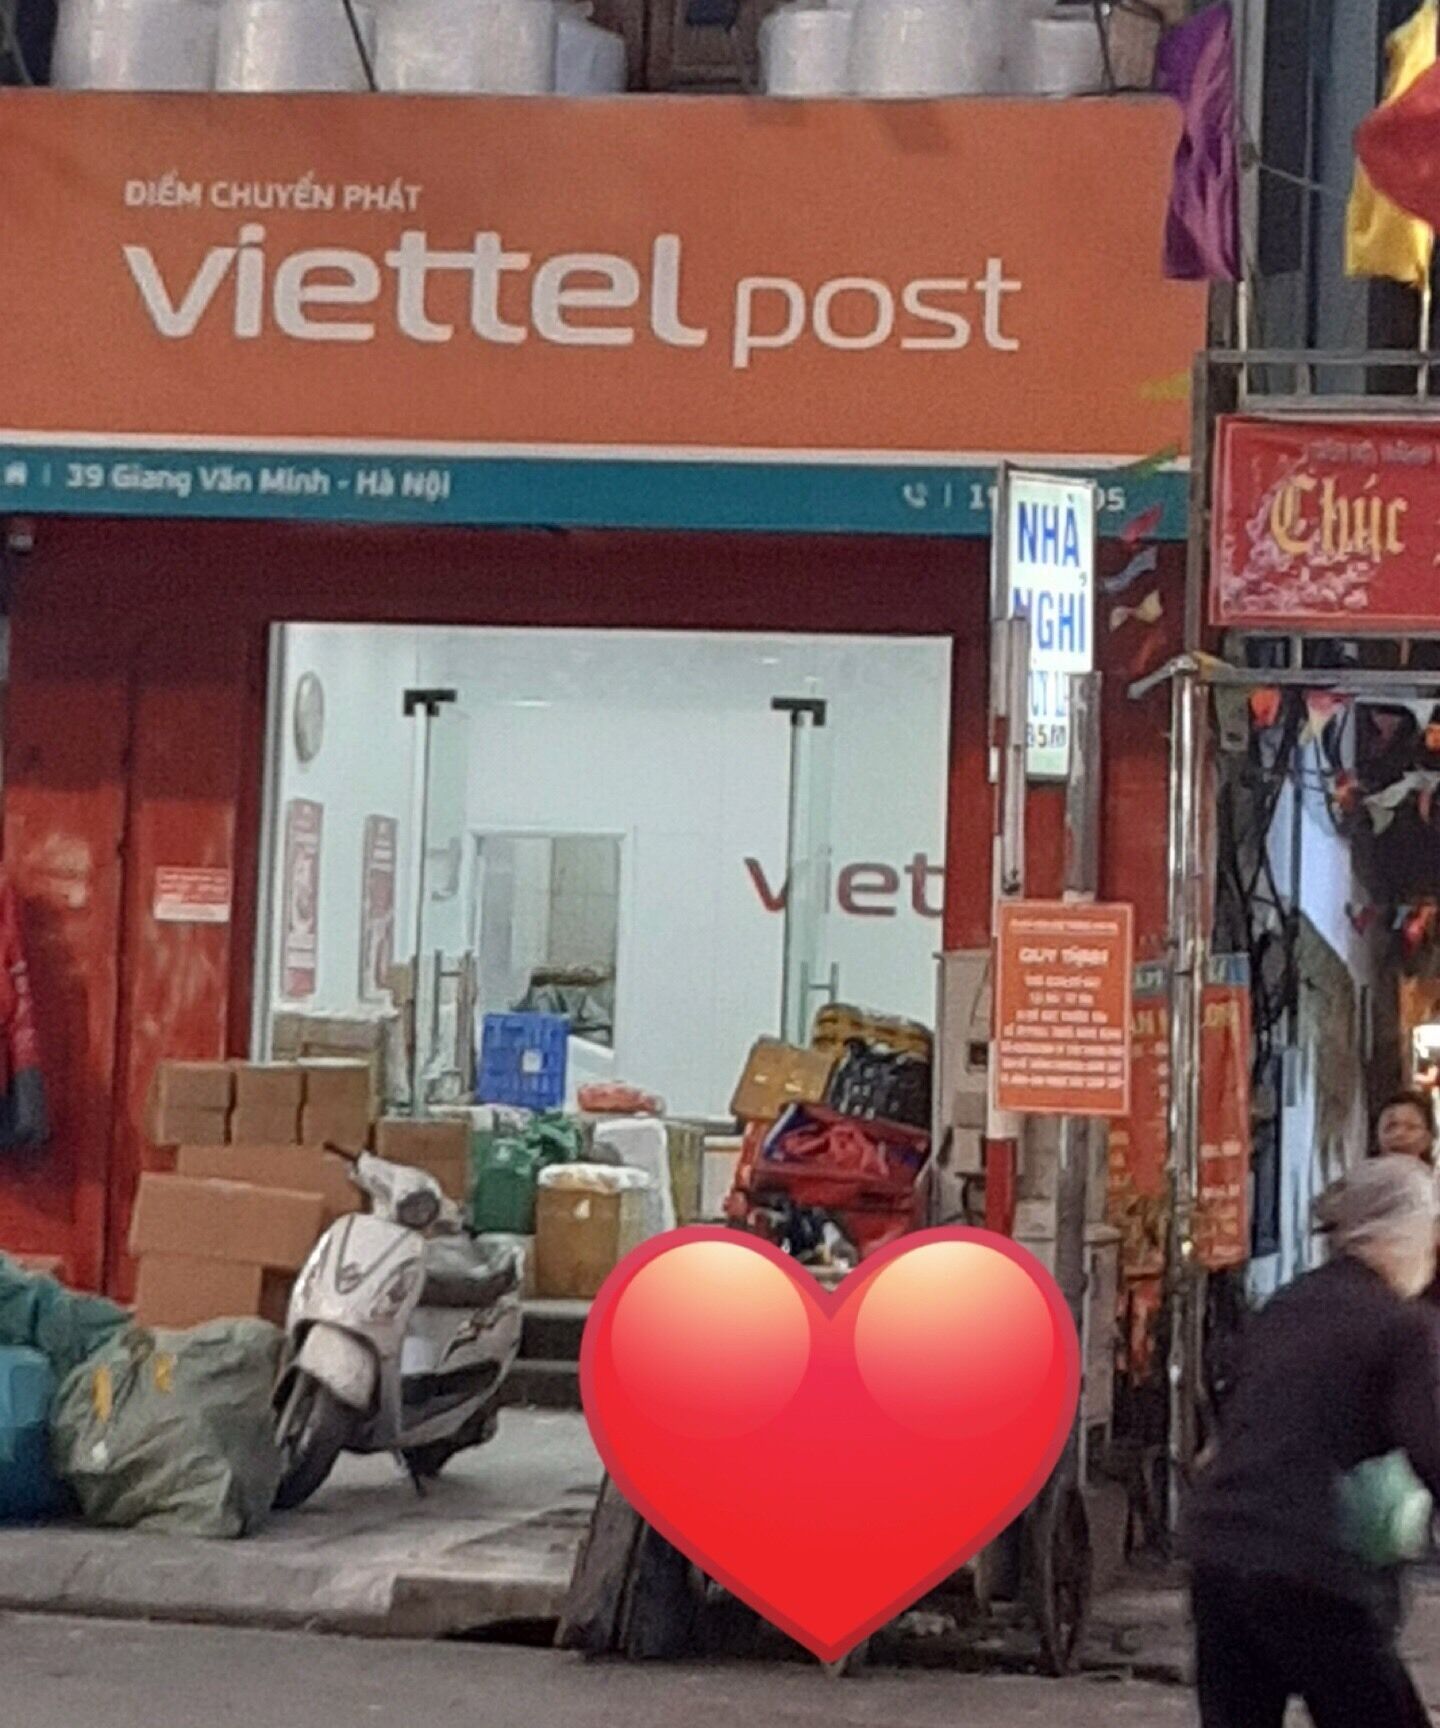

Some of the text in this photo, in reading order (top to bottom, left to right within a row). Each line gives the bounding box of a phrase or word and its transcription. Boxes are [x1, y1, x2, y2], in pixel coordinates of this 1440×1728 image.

[343, 177, 424, 212] PHÁT
[121, 222, 1022, 369] viettel post
[66, 462, 104, 488] 39
[111, 462, 193, 498] Giang
[1017, 494, 1081, 568] NHÀ
